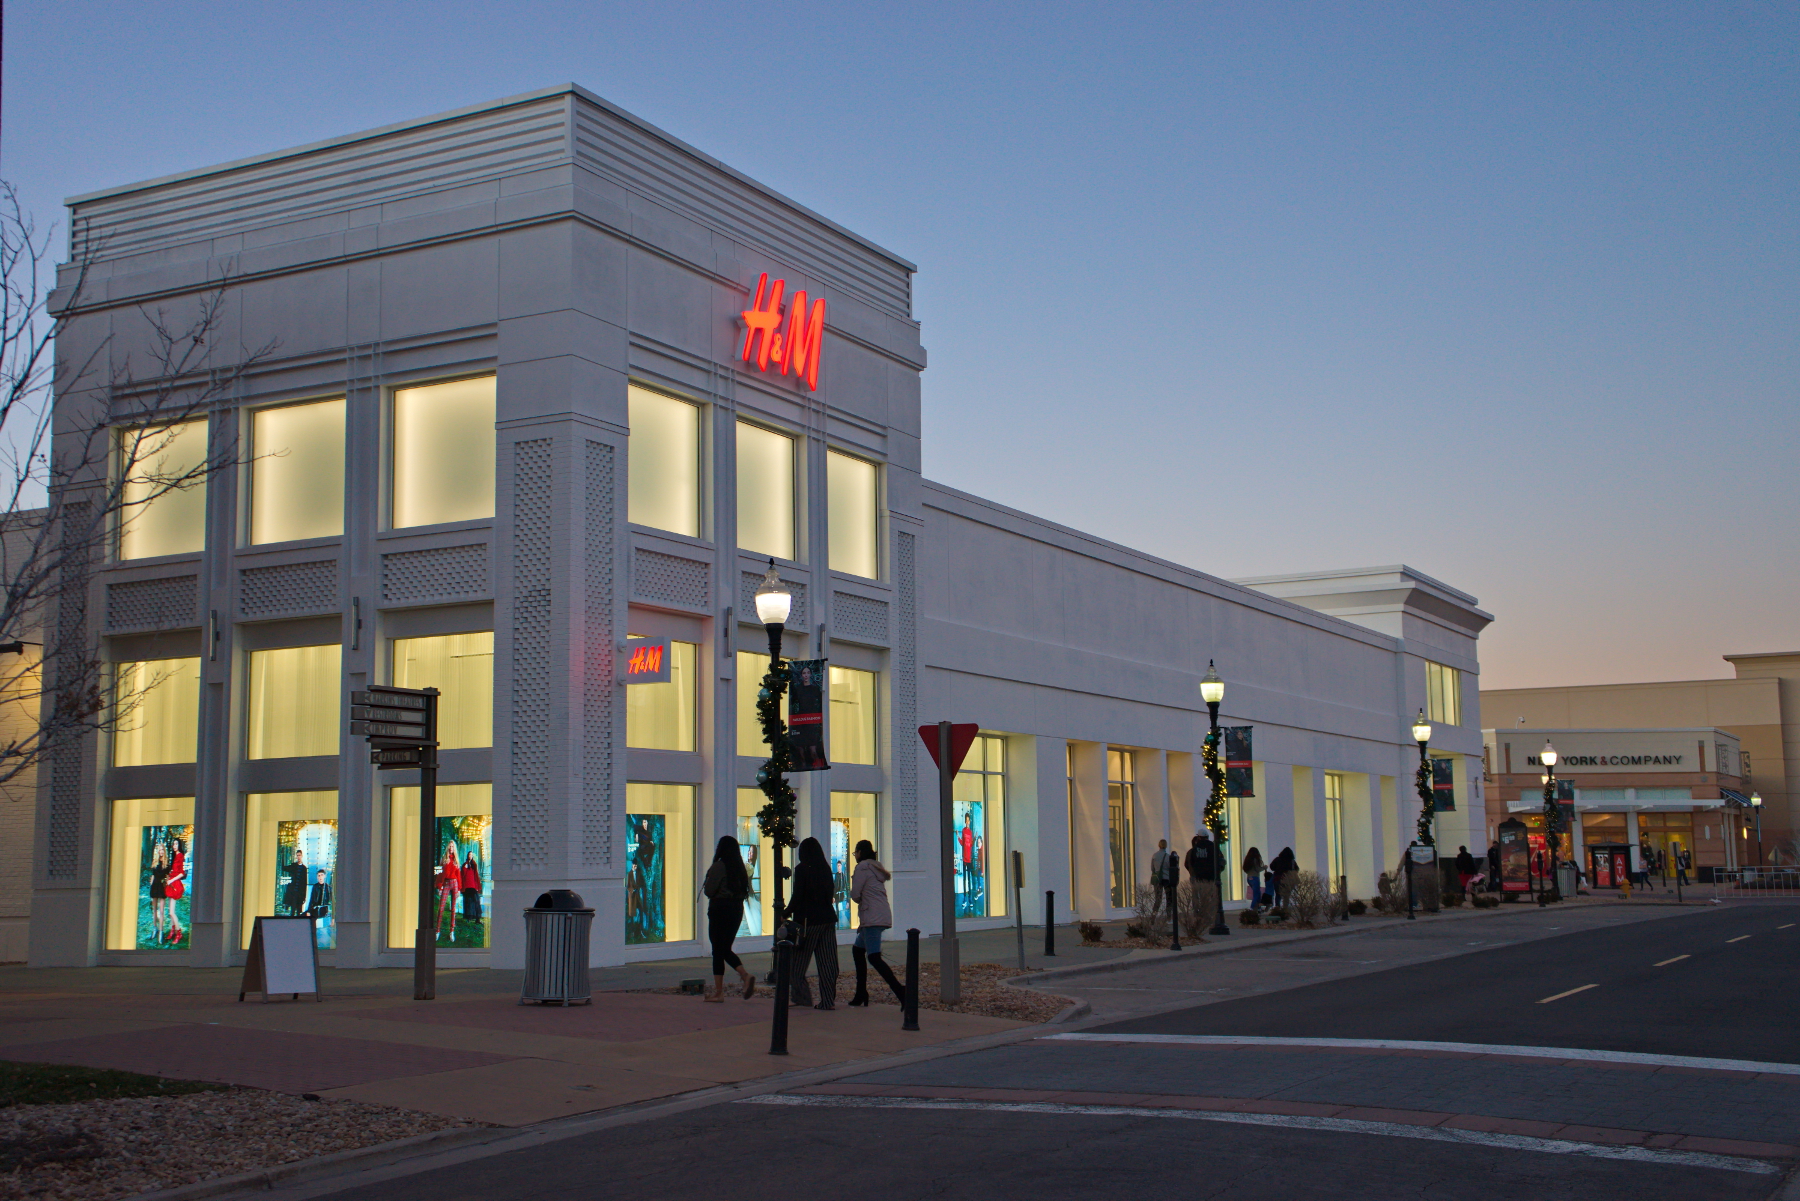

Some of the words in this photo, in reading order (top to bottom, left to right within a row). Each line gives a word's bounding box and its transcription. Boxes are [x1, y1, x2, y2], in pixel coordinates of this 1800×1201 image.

[741, 272, 826, 392] H&M
[628, 645, 664, 675] H&M
[1561, 755, 1598, 766] YORK
[1609, 754, 1682, 766] COMPANY
[1616, 856, 1625, 883] ATM
